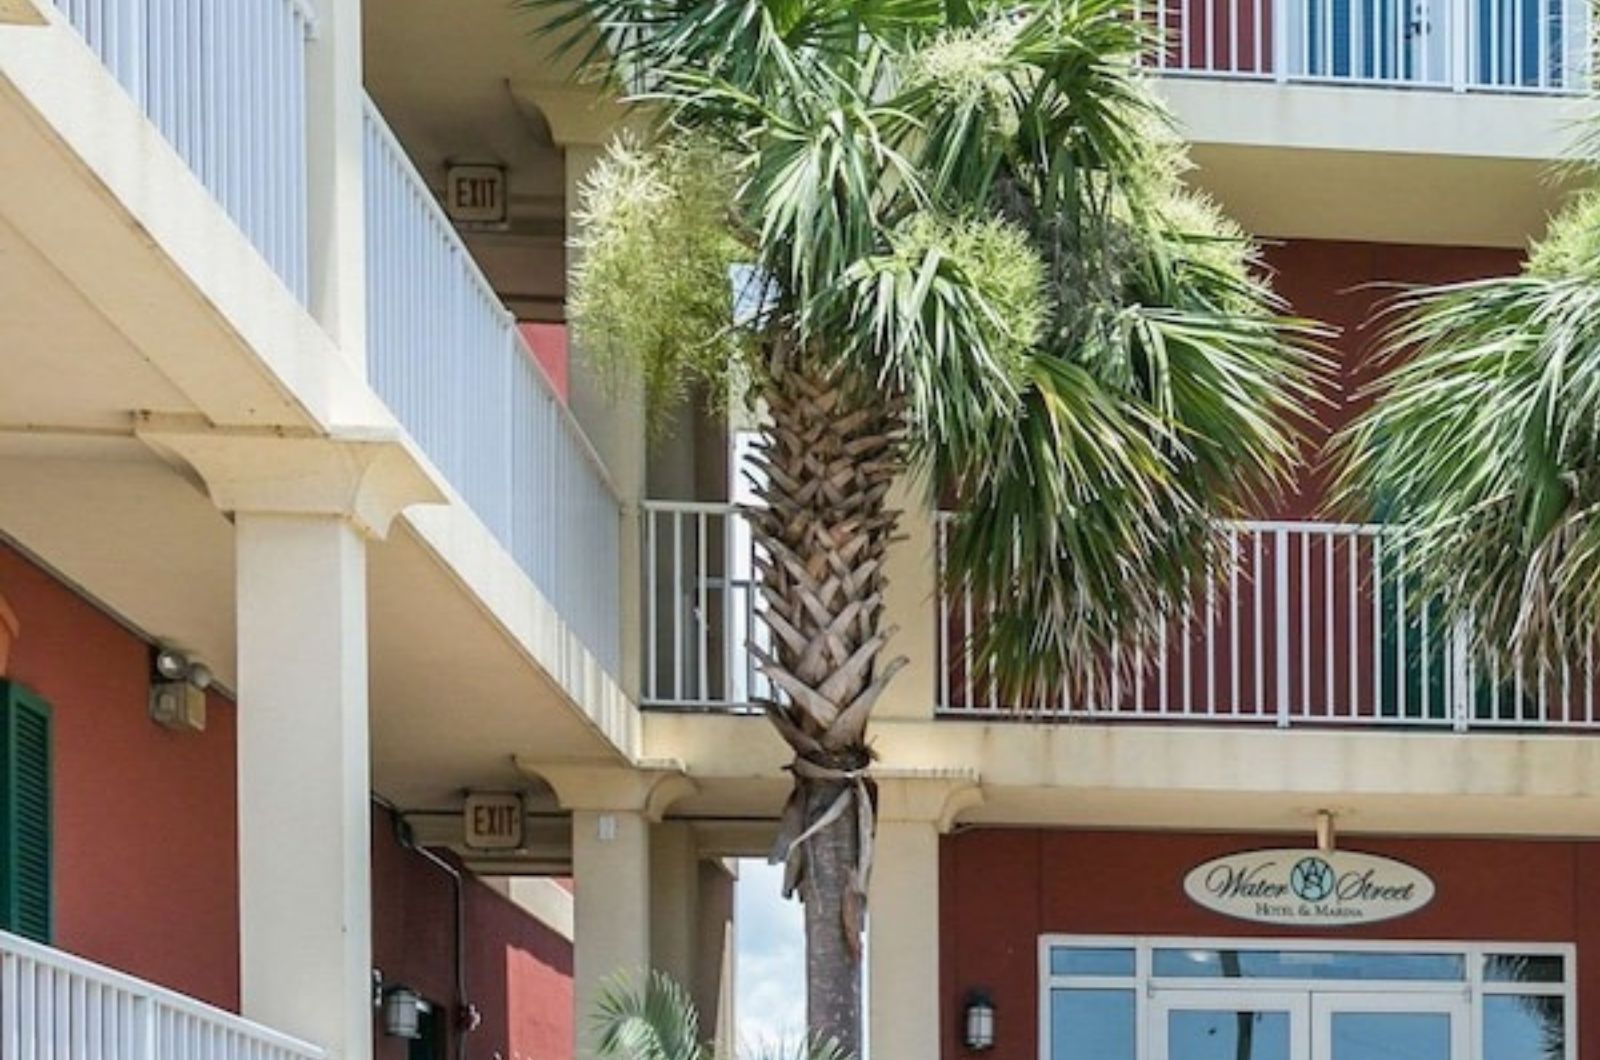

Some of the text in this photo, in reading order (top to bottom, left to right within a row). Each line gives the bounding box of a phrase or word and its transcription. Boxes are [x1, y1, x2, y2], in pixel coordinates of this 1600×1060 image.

[456, 177, 497, 208] EXIT
[474, 805, 516, 836] EXIT
[1205, 861, 1289, 898] Water
[1336, 868, 1415, 901] Street
[1299, 903, 1311, 917] &
